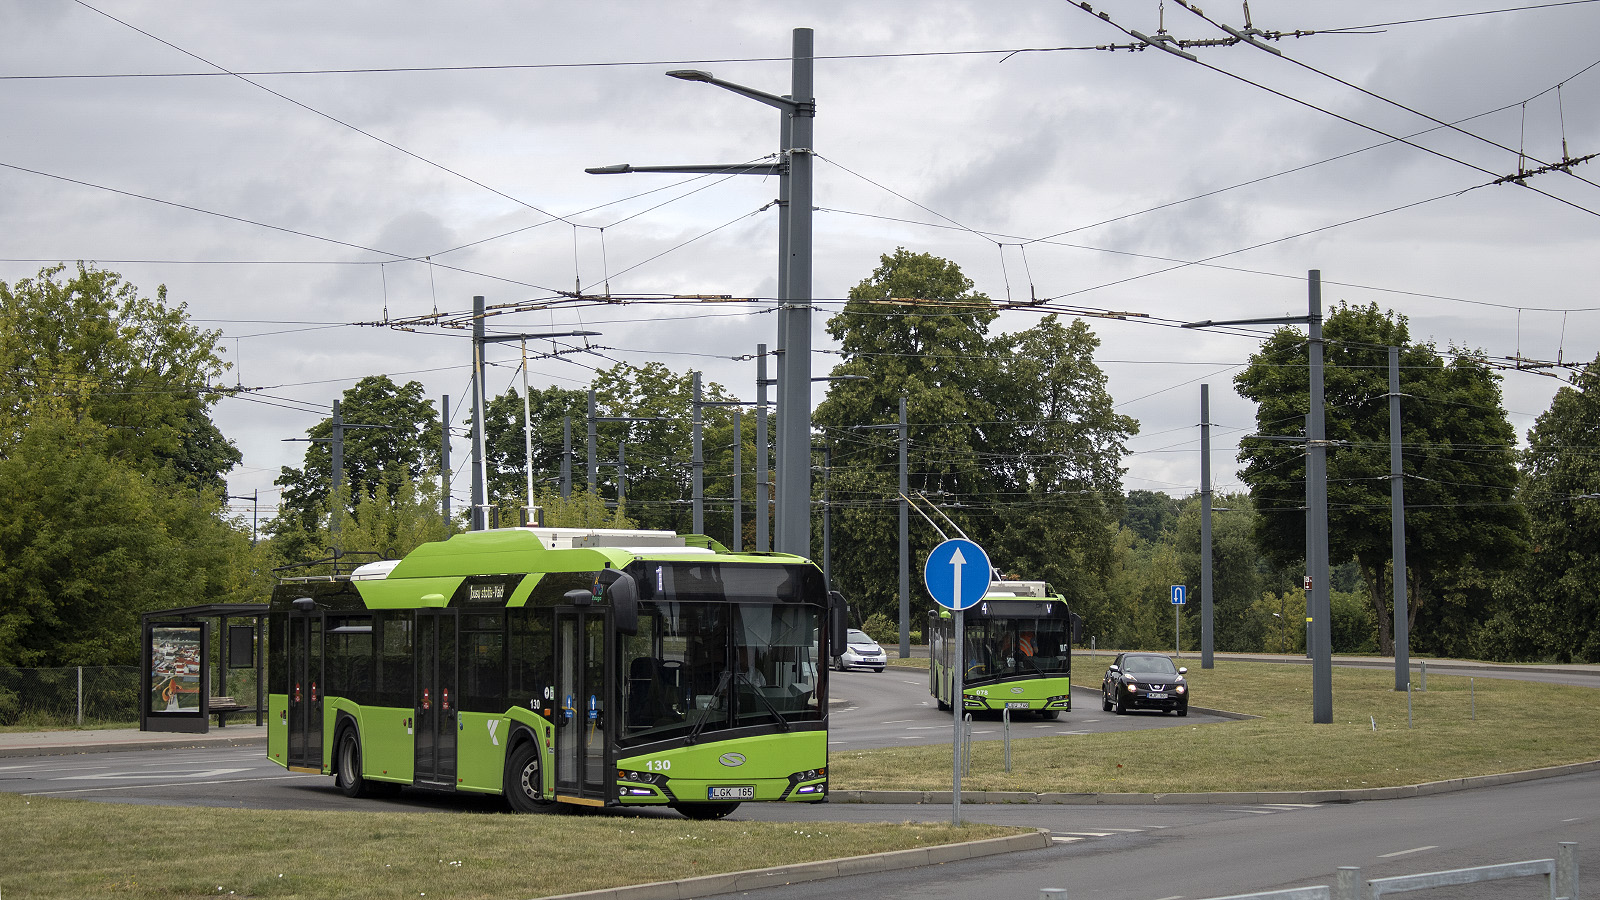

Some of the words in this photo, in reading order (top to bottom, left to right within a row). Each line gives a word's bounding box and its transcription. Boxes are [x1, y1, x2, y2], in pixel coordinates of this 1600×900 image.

[655, 565, 663, 591] 1
[981, 602, 987, 615] 4
[530, 698, 541, 709] 130
[646, 759, 671, 771] 130
[713, 788, 732, 797] LGK
[737, 787, 753, 797] 165
